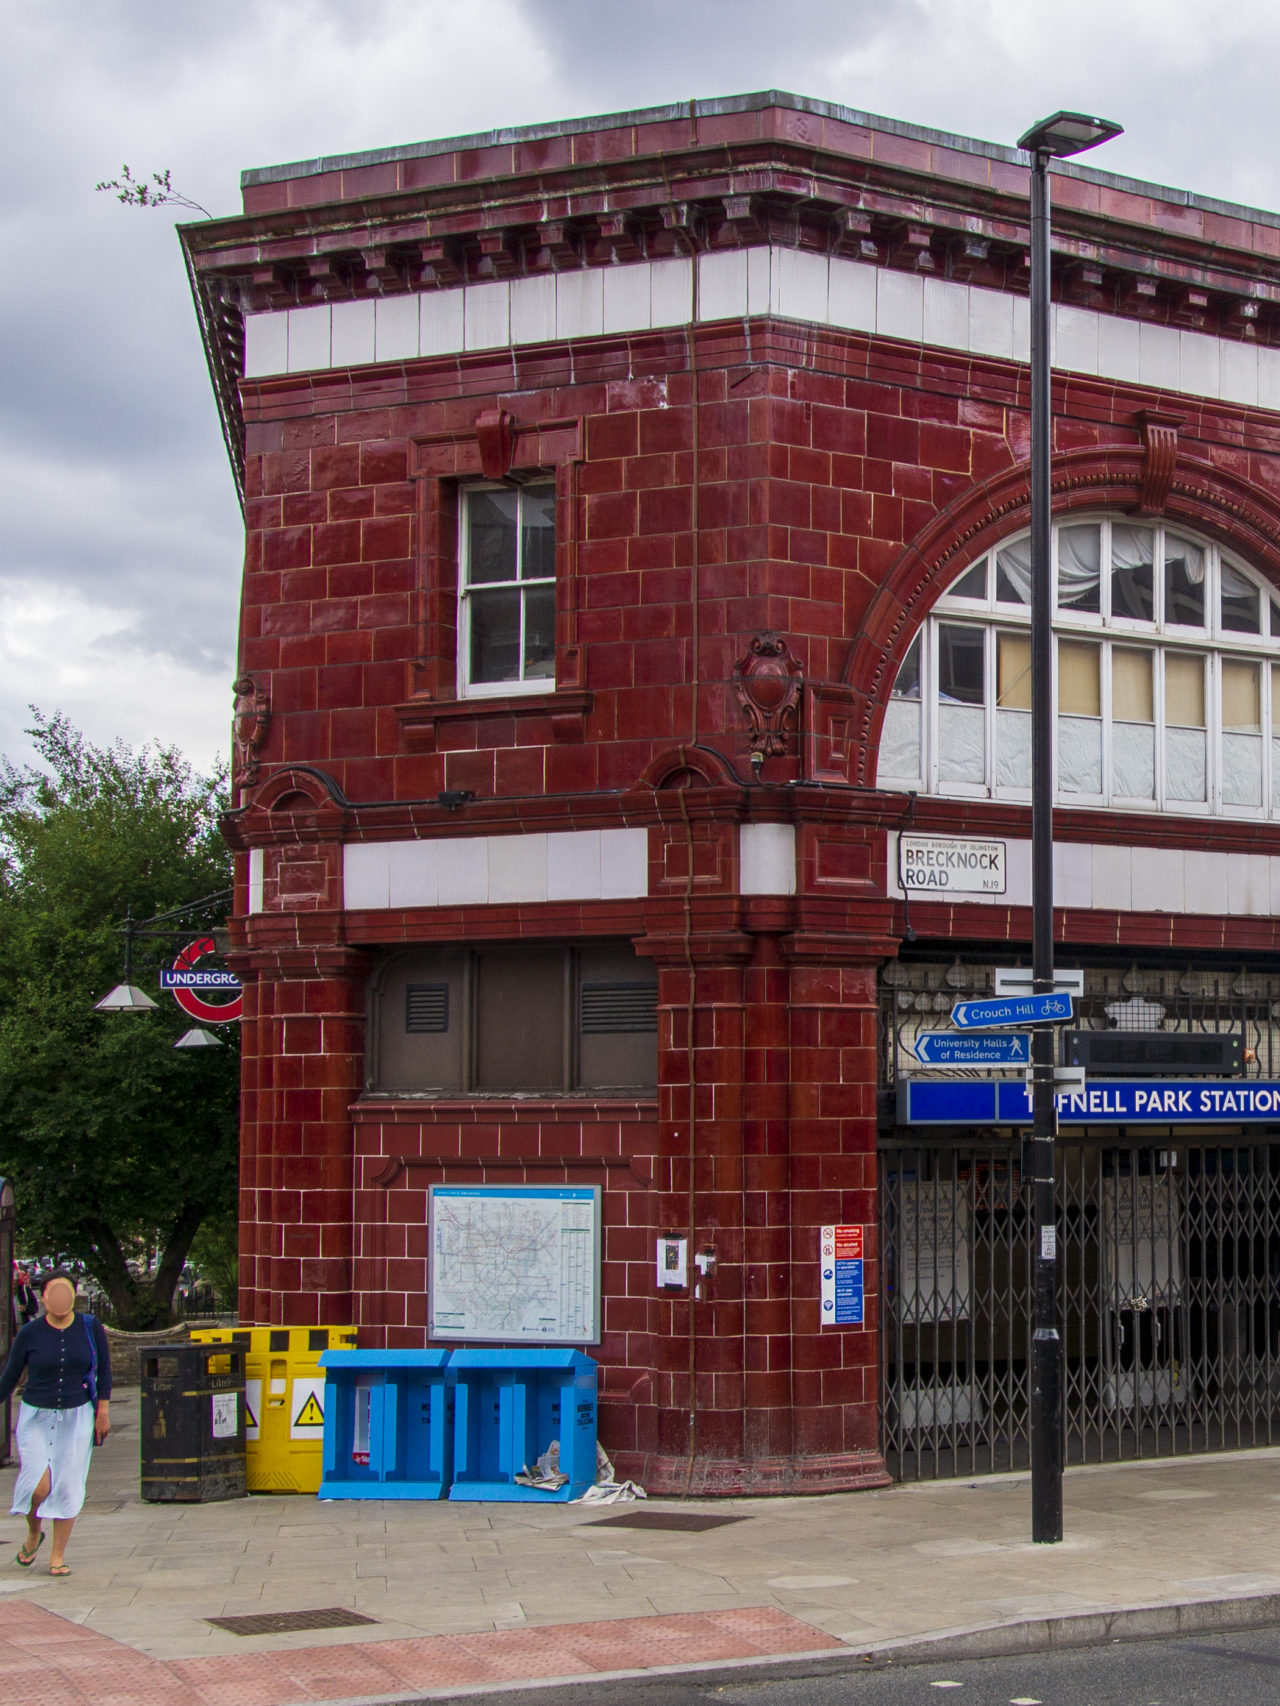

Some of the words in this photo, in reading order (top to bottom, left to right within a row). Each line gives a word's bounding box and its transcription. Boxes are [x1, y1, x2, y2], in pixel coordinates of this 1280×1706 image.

[932, 842, 958, 850] BOROUGH
[970, 844, 999, 852] ISLINGTON
[906, 849, 1000, 870] BRECKNOCK
[906, 868, 950, 887] ROAD
[971, 1007, 1012, 1020] Crouch
[1016, 1004, 1035, 1015] Hill
[934, 1039, 980, 1049] University
[983, 1039, 1008, 1048] Halls
[940, 1050, 951, 1059] of
[954, 1050, 1001, 1060] Residence
[1024, 1090, 1127, 1112] TFNELL
[1134, 1090, 1192, 1112] PARK
